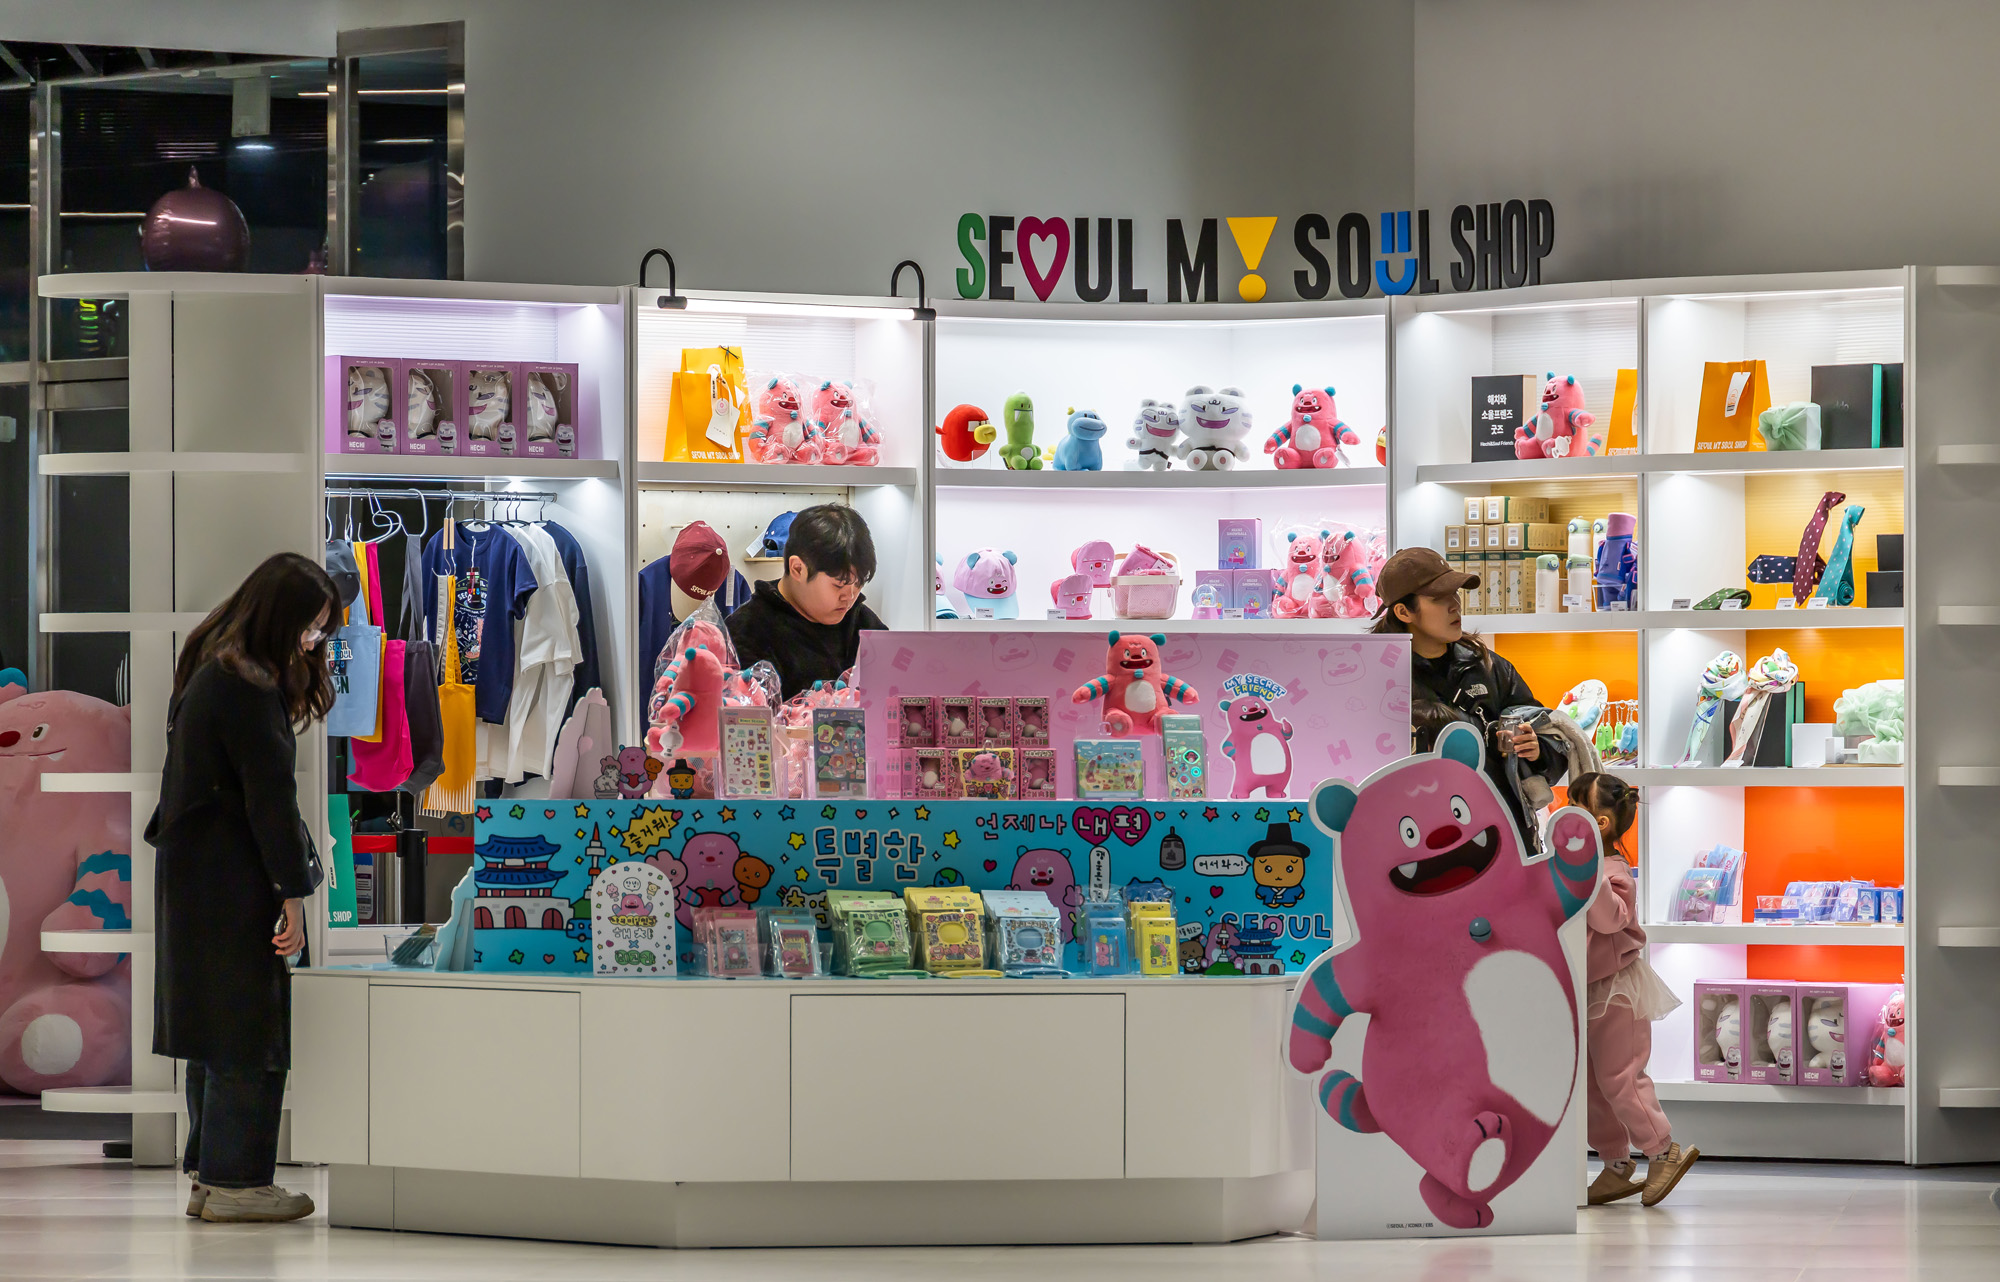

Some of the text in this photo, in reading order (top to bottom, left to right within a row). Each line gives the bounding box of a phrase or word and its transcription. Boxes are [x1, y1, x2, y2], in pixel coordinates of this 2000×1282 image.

[1294, 210, 1439, 298] SOUL
[1450, 199, 1555, 292] SHOP
[1487, 394, 1507, 405] 해치와
[1481, 409, 1513, 420] 소울프렌즈
[1491, 425, 1504, 435] 굿즈
[1734, 440, 1748, 449] SHOP
[1224, 673, 1286, 697] MY SECRET
[1234, 684, 1275, 701] FRIEND
[629, 816, 671, 848] 즐거워!
[976, 813, 1067, 840] 언제나
[814, 827, 925, 885] 특별한
[333, 911, 352, 922] SHOP
